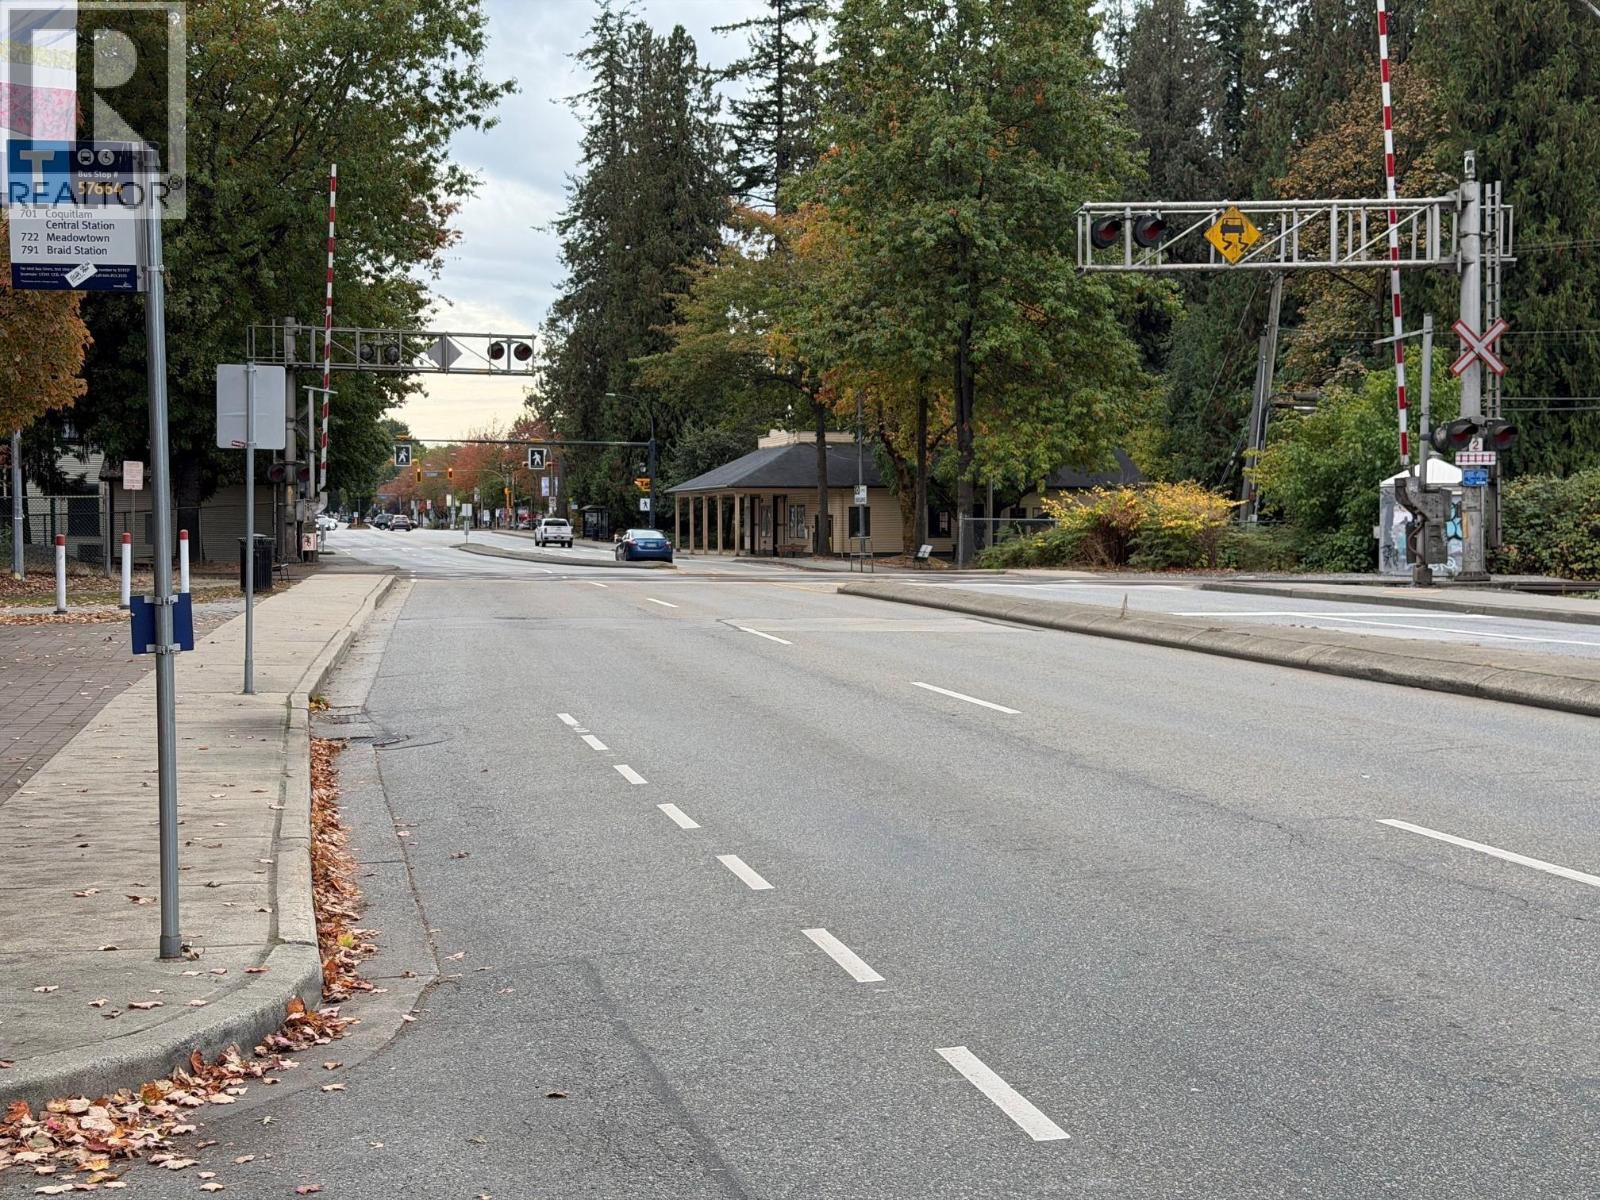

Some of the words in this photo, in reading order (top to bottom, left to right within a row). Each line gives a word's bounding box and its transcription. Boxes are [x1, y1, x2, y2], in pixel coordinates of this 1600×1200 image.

[78, 170, 92, 178] Bus
[94, 170, 112, 180] Stop
[78, 181, 123, 195] 57664
[20, 209, 37, 219] 701
[45, 209, 93, 221] Coquitlam
[46, 220, 79, 230] Central
[82, 220, 115, 231] Station
[21, 232, 39, 242] 722
[46, 232, 110, 243] Meadowtown
[21, 245, 39, 255] 791
[47, 245, 71, 255] Braid
[74, 245, 108, 256] Station
[1472, 440, 1480, 450] 2
